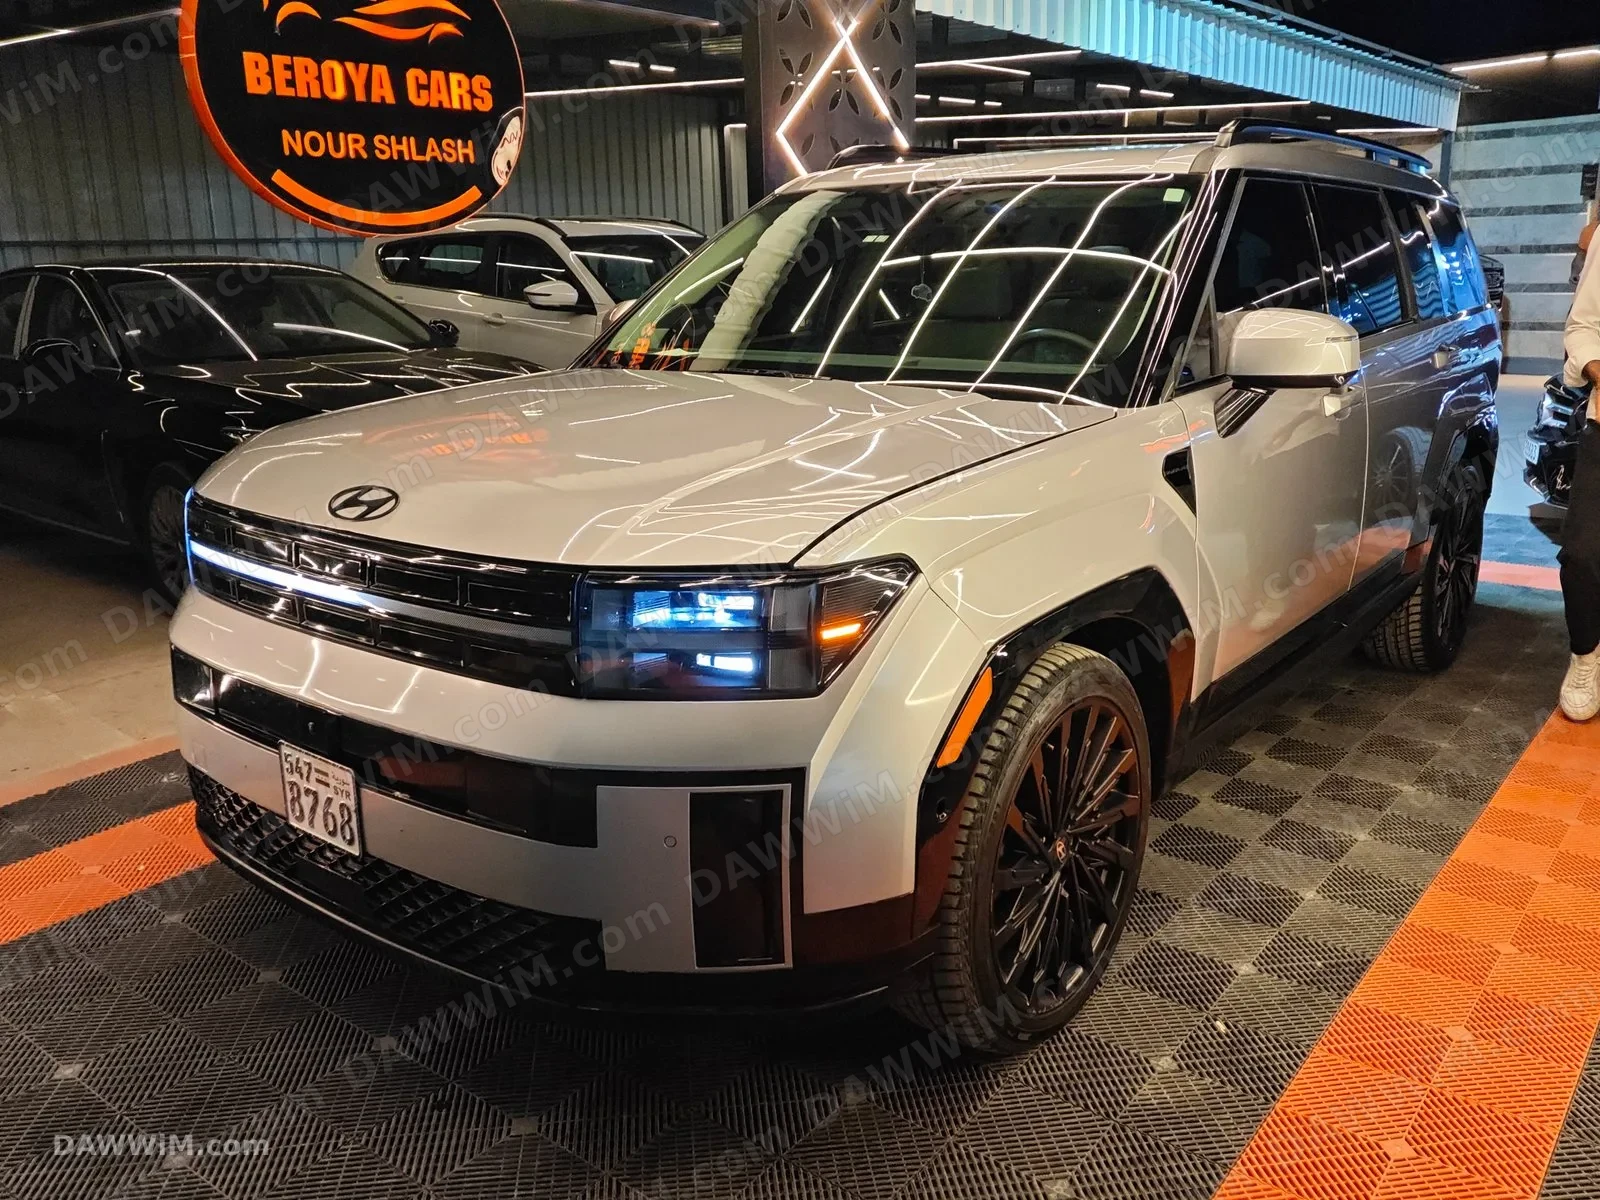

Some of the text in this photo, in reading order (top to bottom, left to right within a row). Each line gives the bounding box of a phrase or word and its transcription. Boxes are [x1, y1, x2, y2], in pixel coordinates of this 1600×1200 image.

[242, 51, 493, 112] BEROYA CARS
[281, 128, 475, 164] NOUR SHLASH
[284, 752, 312, 784] 547
[333, 786, 352, 801] SYR
[287, 780, 355, 847] 8768
